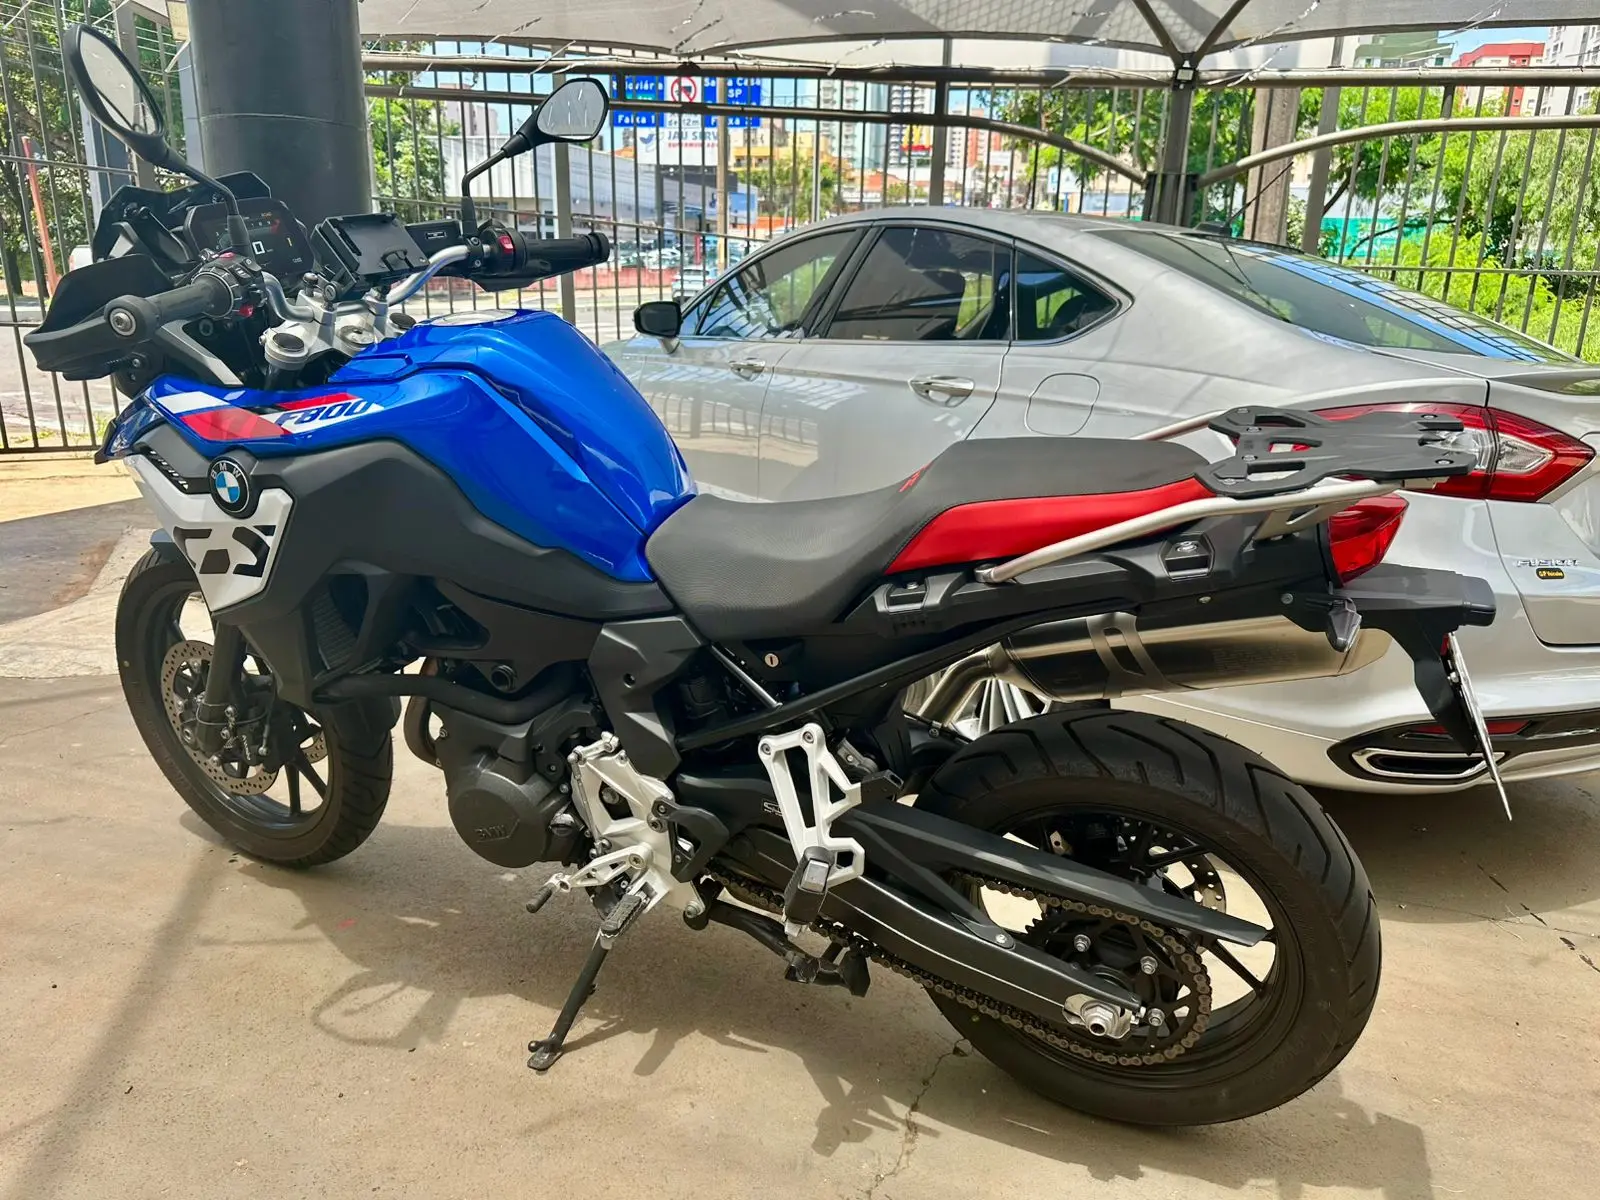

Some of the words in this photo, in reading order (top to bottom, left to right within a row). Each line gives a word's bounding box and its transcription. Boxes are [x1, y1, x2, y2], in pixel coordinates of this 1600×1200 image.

[727, 88, 743, 98] SP
[710, 115, 741, 126] Fxa
[275, 400, 367, 426] F800
[210, 461, 242, 480] BMW
